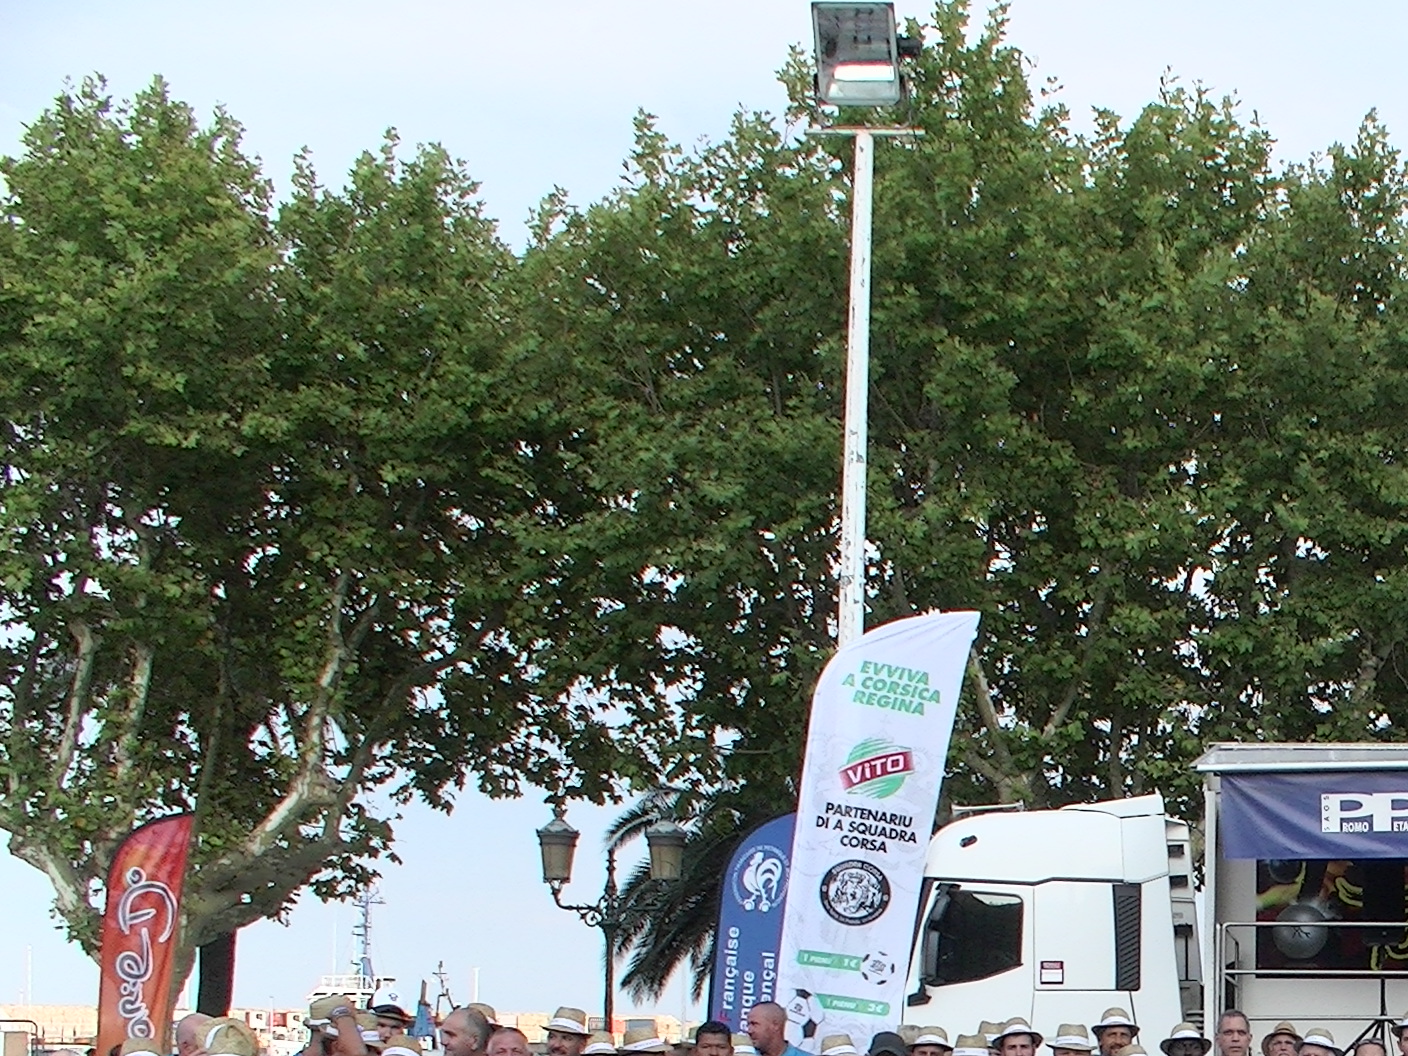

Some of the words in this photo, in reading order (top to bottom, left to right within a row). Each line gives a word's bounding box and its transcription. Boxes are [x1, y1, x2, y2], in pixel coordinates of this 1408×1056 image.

[860, 660, 930, 686] EVVIVA
[842, 673, 856, 688] A
[860, 676, 941, 704] CORSICA
[852, 689, 925, 716] REGINA
[825, 802, 913, 828] PARTENARIU
[816, 816, 830, 829] DI
[833, 820, 844, 832] A
[848, 821, 918, 845] SQUADRA
[840, 835, 888, 854] CORSA
[717, 926, 741, 1023] Française
